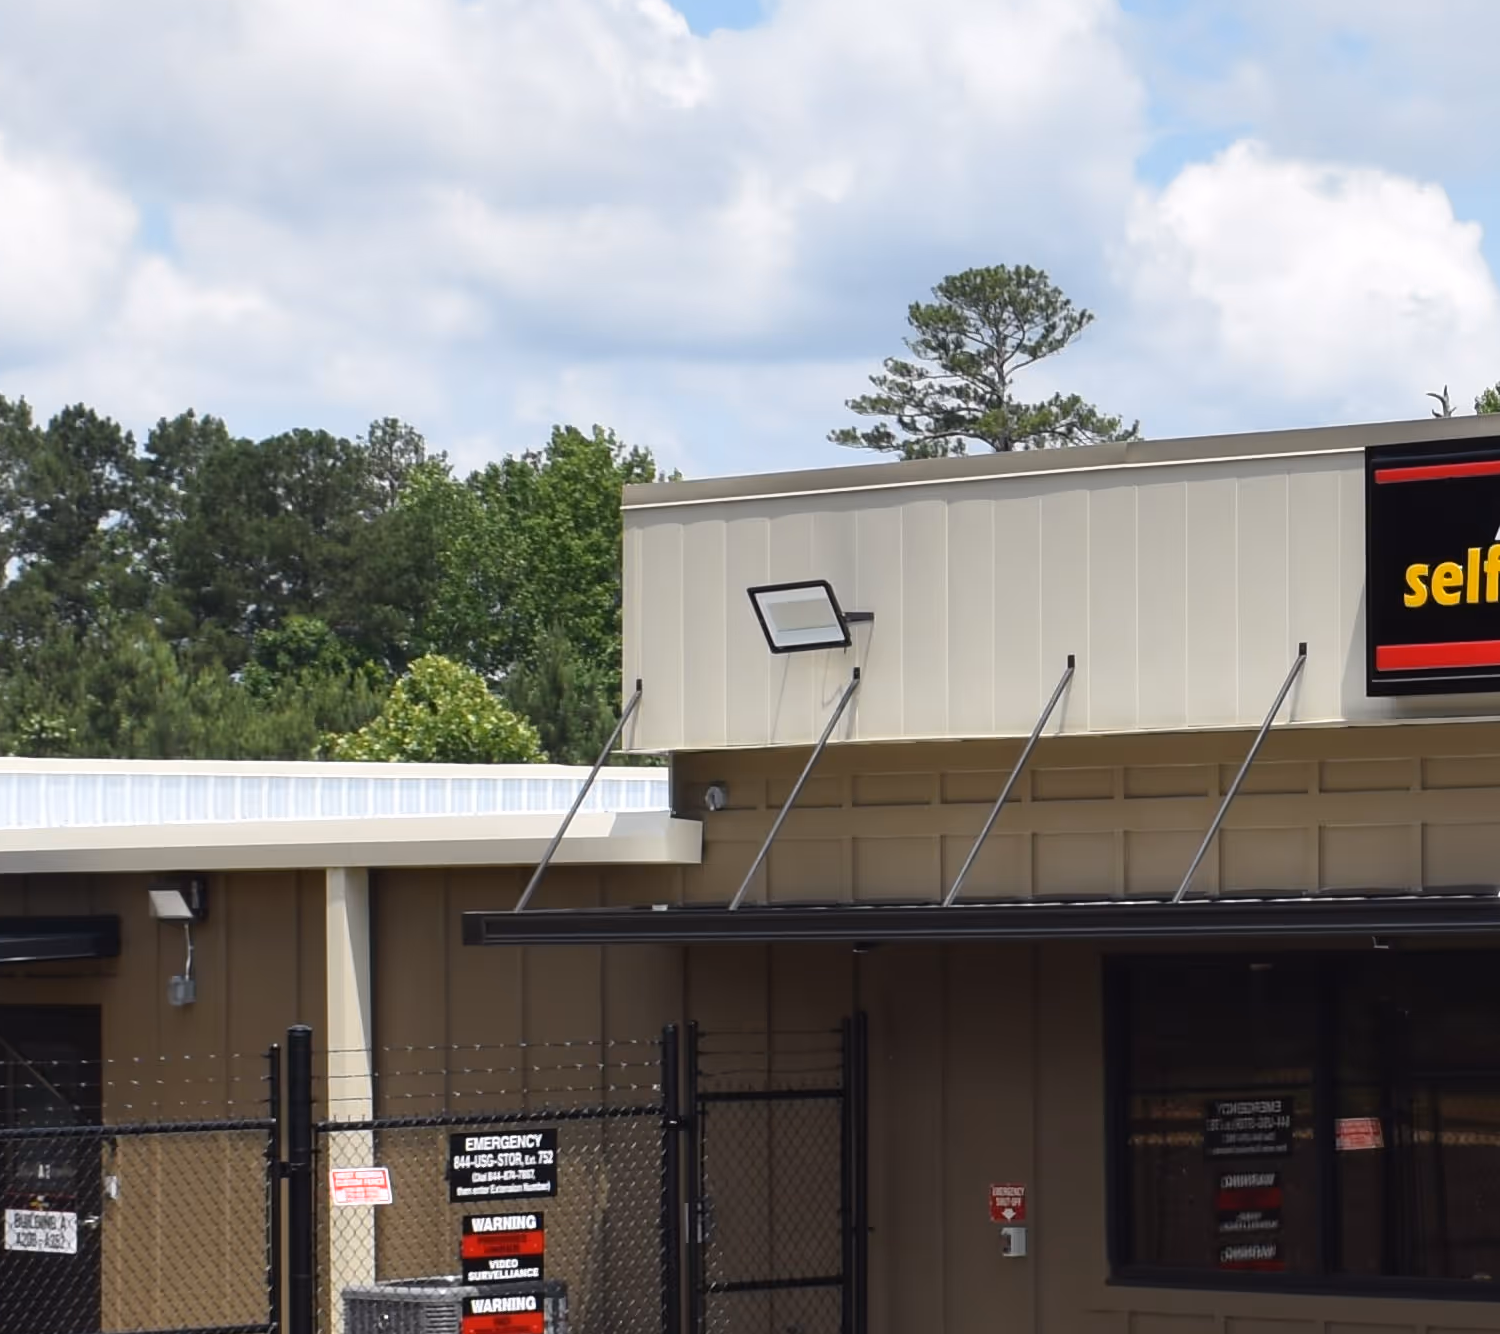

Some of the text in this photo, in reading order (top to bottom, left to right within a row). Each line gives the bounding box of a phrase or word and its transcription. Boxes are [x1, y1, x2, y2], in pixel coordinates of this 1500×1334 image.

[465, 1133, 543, 1152] EMERGENCY
[538, 1150, 554, 1164] 752
[471, 1215, 536, 1232] WARNING
[488, 1259, 519, 1270] VIDEO
[470, 1296, 536, 1314] WARNING
